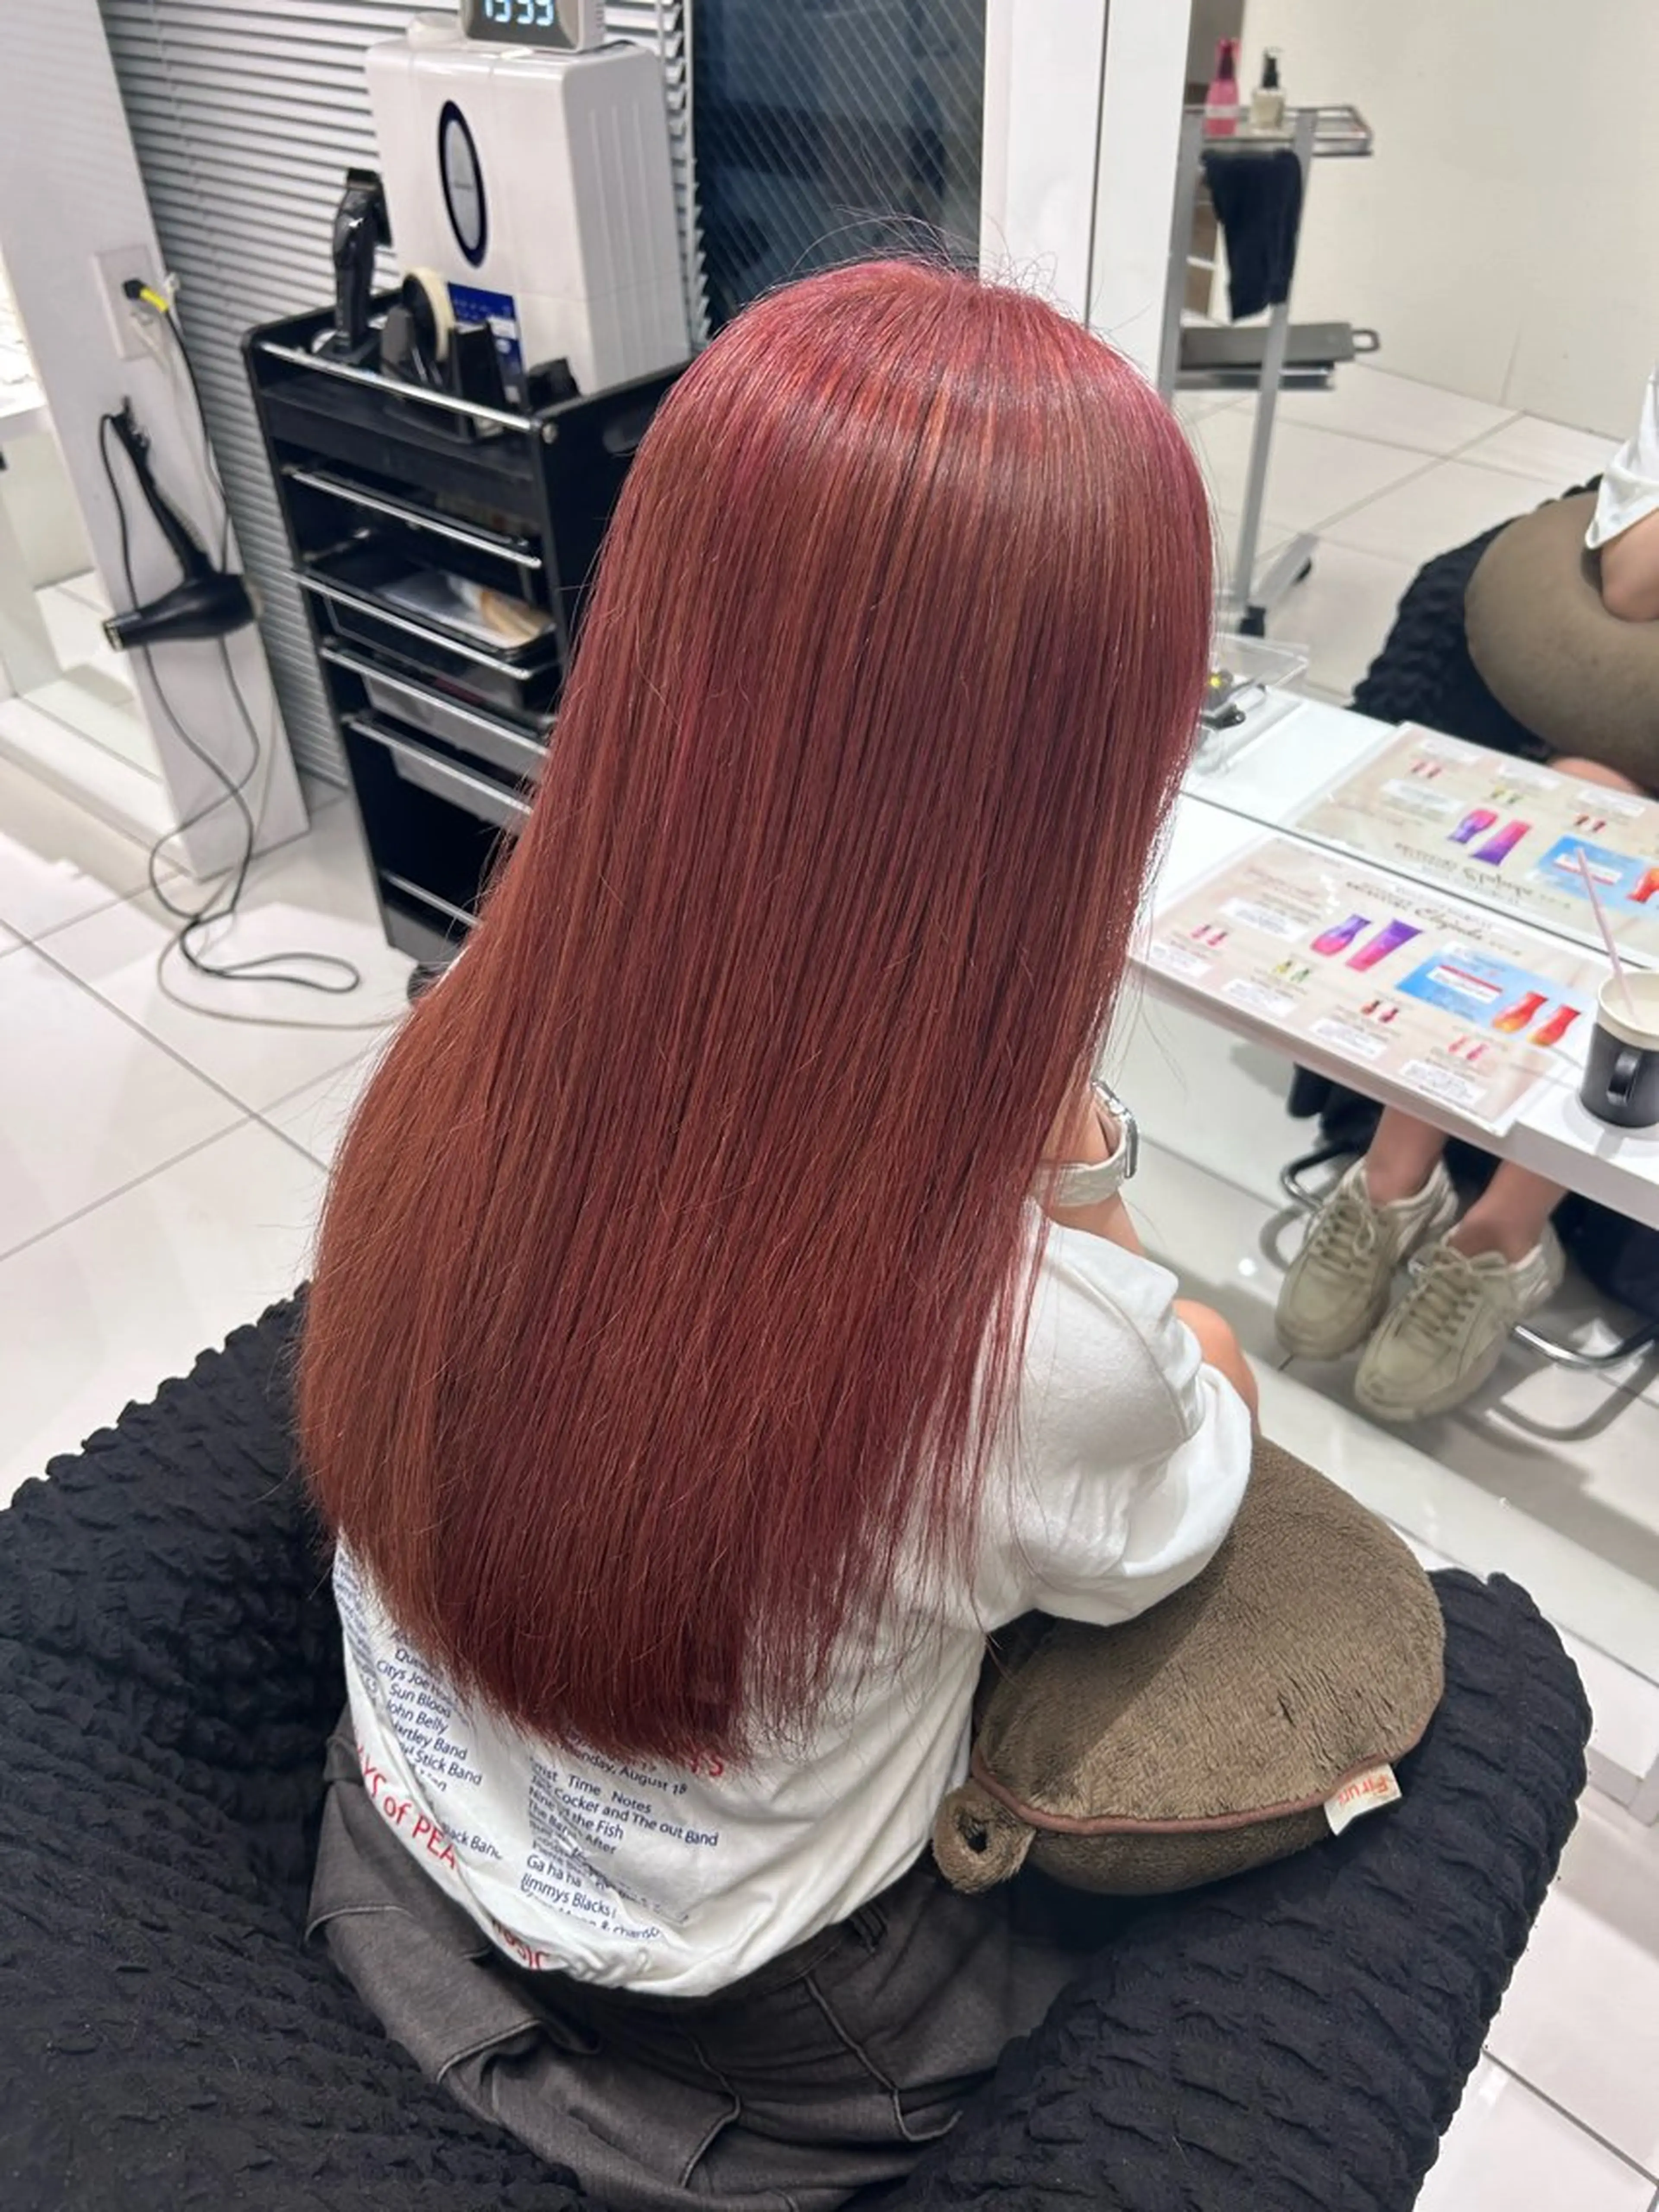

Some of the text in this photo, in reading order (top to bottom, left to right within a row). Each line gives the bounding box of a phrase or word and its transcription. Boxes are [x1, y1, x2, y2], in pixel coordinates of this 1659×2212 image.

[389, 1682, 416, 1702] Sun
[416, 1711, 449, 1735] Belly
[433, 1737, 468, 1761] Band
[414, 1748, 446, 1774] Stick
[448, 1762, 483, 1786] Band
[619, 1765, 668, 1792] August
[672, 1783, 688, 1796] 18
[569, 1773, 601, 1796] Time
[611, 1790, 652, 1814] Notes
[596, 1819, 624, 1840] Fish
[602, 1805, 629, 1822] and
[632, 1812, 658, 1831] The
[659, 1822, 683, 1839] out
[527, 1854, 545, 1872] Ga
[572, 1891, 610, 1917] Blacks
